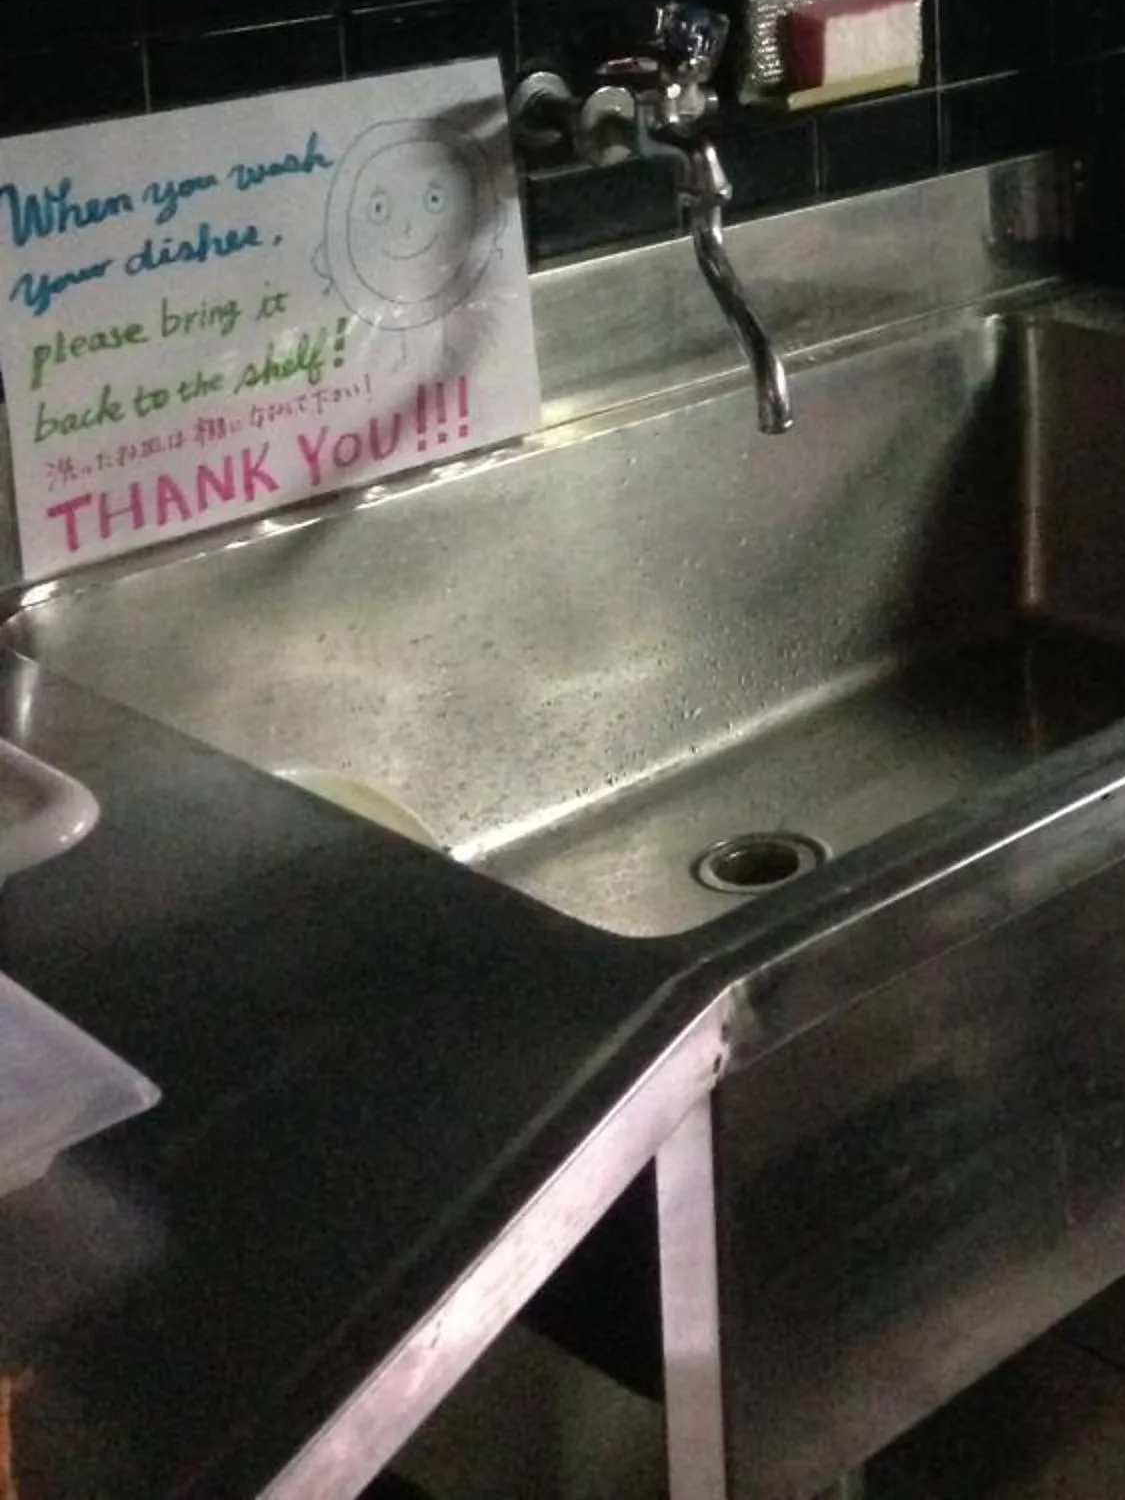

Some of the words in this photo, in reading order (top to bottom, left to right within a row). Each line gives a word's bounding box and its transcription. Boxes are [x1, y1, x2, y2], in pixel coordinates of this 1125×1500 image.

[0, 176, 133, 246] When
[142, 173, 218, 225] you
[227, 132, 334, 190] wash
[9, 259, 115, 316] your
[31, 321, 149, 390] please
[160, 298, 242, 336] bring
[255, 280, 289, 320] it
[33, 384, 126, 443] back
[132, 386, 170, 419] to
[175, 369, 225, 403] the
[46, 441, 280, 553] THANK
